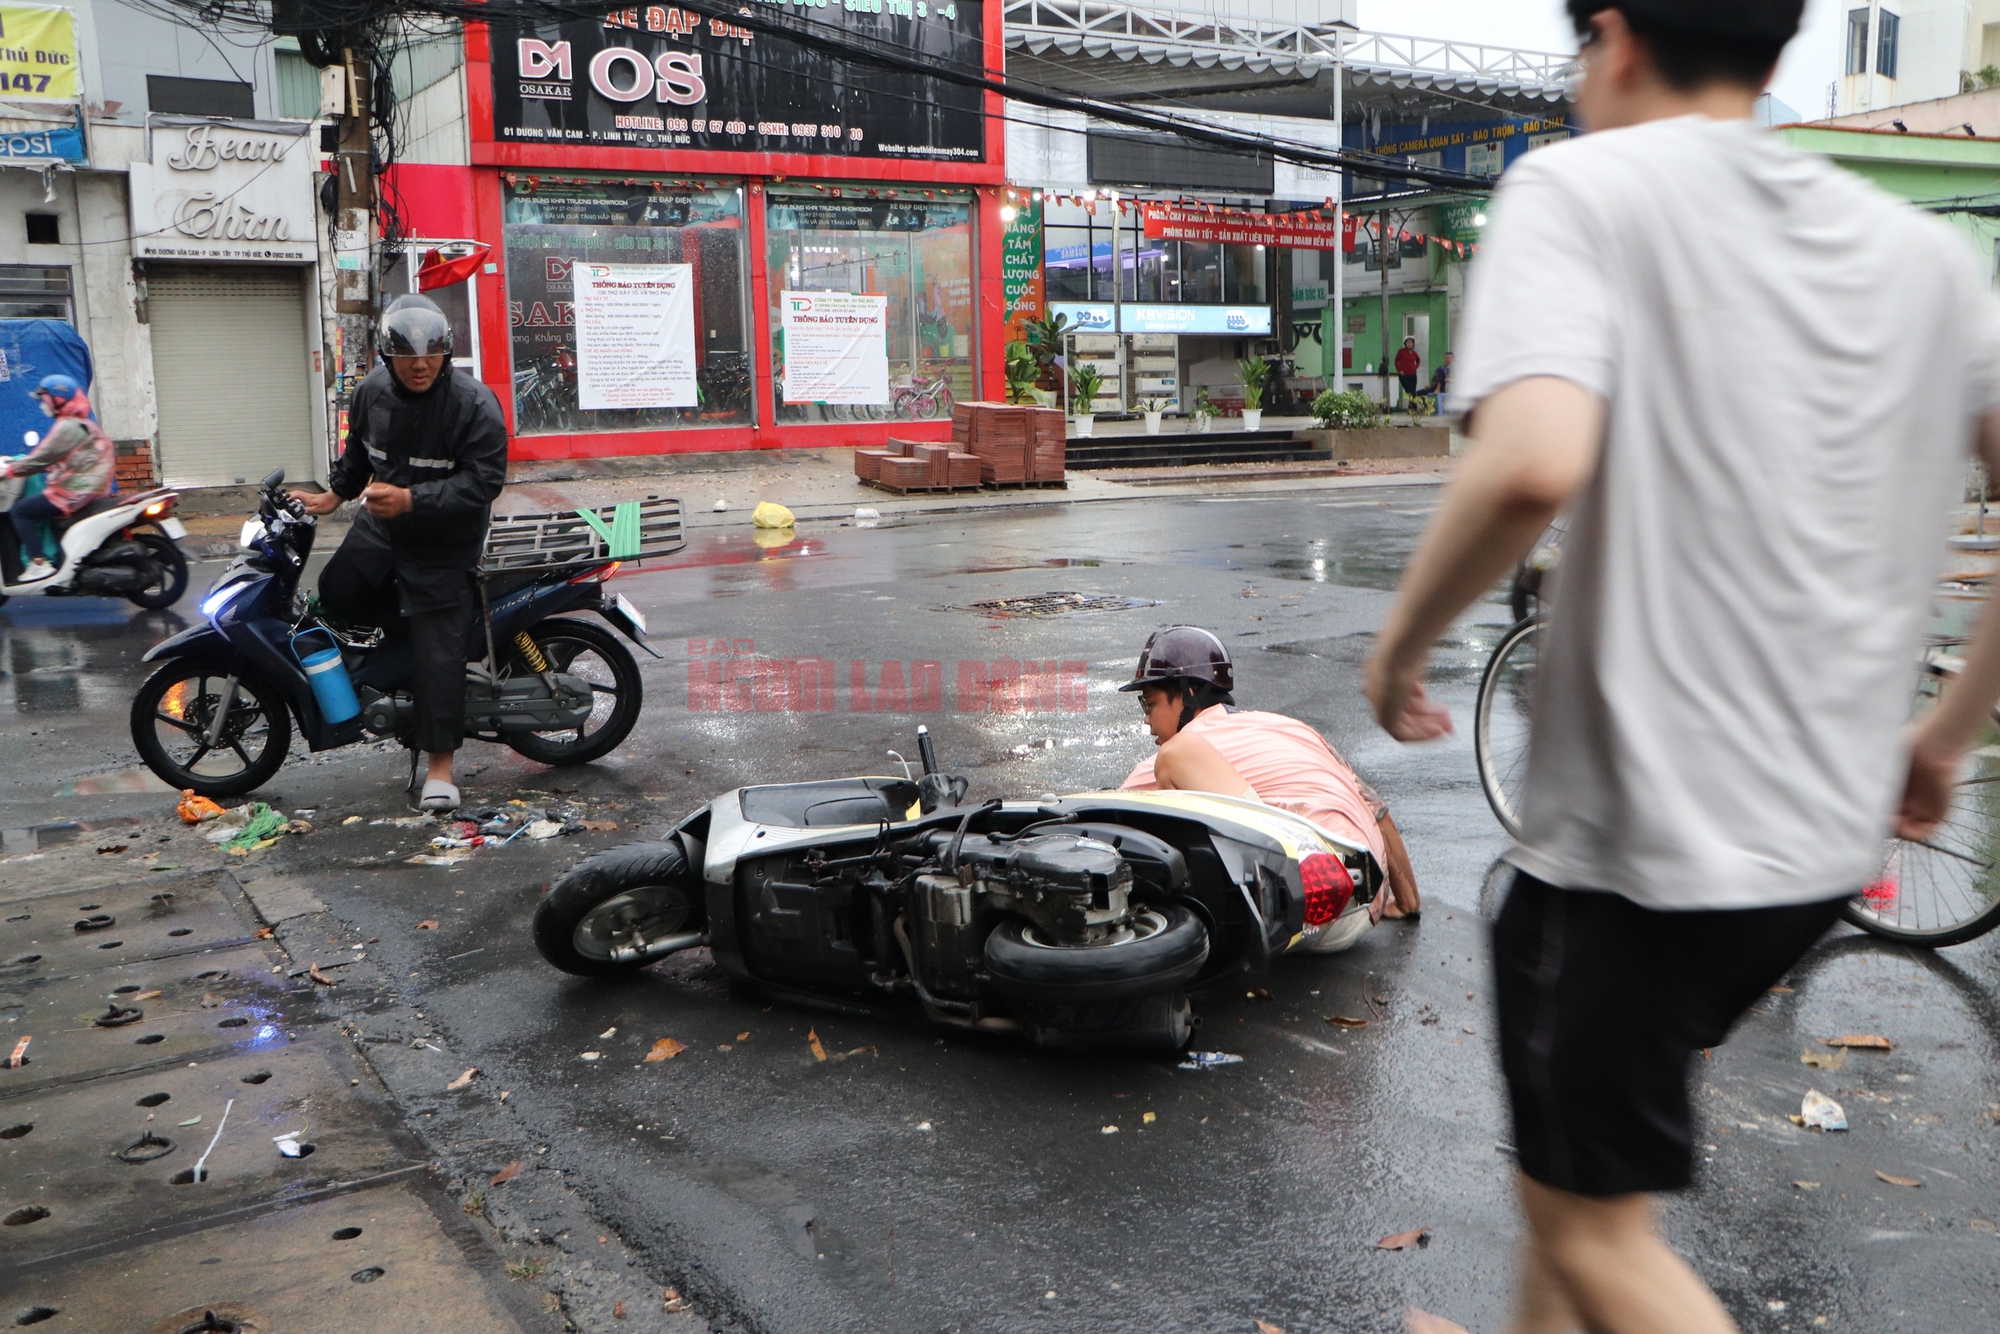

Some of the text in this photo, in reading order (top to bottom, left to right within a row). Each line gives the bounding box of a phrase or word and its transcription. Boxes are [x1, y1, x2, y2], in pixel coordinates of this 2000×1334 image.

[646, 6, 701, 40] ĐẠP
[36, 50, 70, 65] Đức
[588, 46, 707, 106] OS
[520, 84, 572, 97] OSAKAR
[616, 115, 665, 131] HOTLINE:
[667, 118, 689, 132] 093
[691, 119, 706, 133] 67
[709, 120, 724, 134] 67
[725, 121, 746, 135] 400
[758, 122, 789, 136] CSKH:
[792, 123, 818, 138] 0937
[821, 124, 842, 139] 310
[504, 127, 514, 137] 01
[547, 127, 562, 138] VĂN
[565, 130, 583, 139] CAM
[604, 132, 620, 141] LINH
[624, 131, 638, 142] TÂY
[646, 133, 654, 143] Q.
[658, 132, 672, 143] THỦ
[675, 133, 690, 144] ĐỨC
[1399, 138, 1428, 153] CAMERA
[1429, 137, 1448, 150] QUAN
[1450, 131, 1465, 145] SÁT
[1492, 124, 1514, 140] TRỘM
[1523, 119, 1540, 134] BÁO
[878, 143, 906, 153] Website:
[1004, 221, 1035, 234] NÂNG
[1249, 231, 1262, 243] LIÊN
[1005, 251, 1034, 265] CHẤT
[1061, 247, 1088, 260] SAMSUN
[1002, 269, 1040, 282] LƯỢNG
[592, 280, 616, 289] THÔNG
[617, 280, 632, 289] BÁO
[657, 282, 676, 290] DỤNG
[1006, 283, 1035, 297] CUỘC
[1006, 297, 1036, 311] SỐNG
[793, 314, 818, 323] THÔNG
[819, 314, 834, 323] BÁO
[859, 316, 878, 325] DỤNG
[1136, 308, 1195, 321] KBVISION
[535, 330, 562, 344] Khẳng
